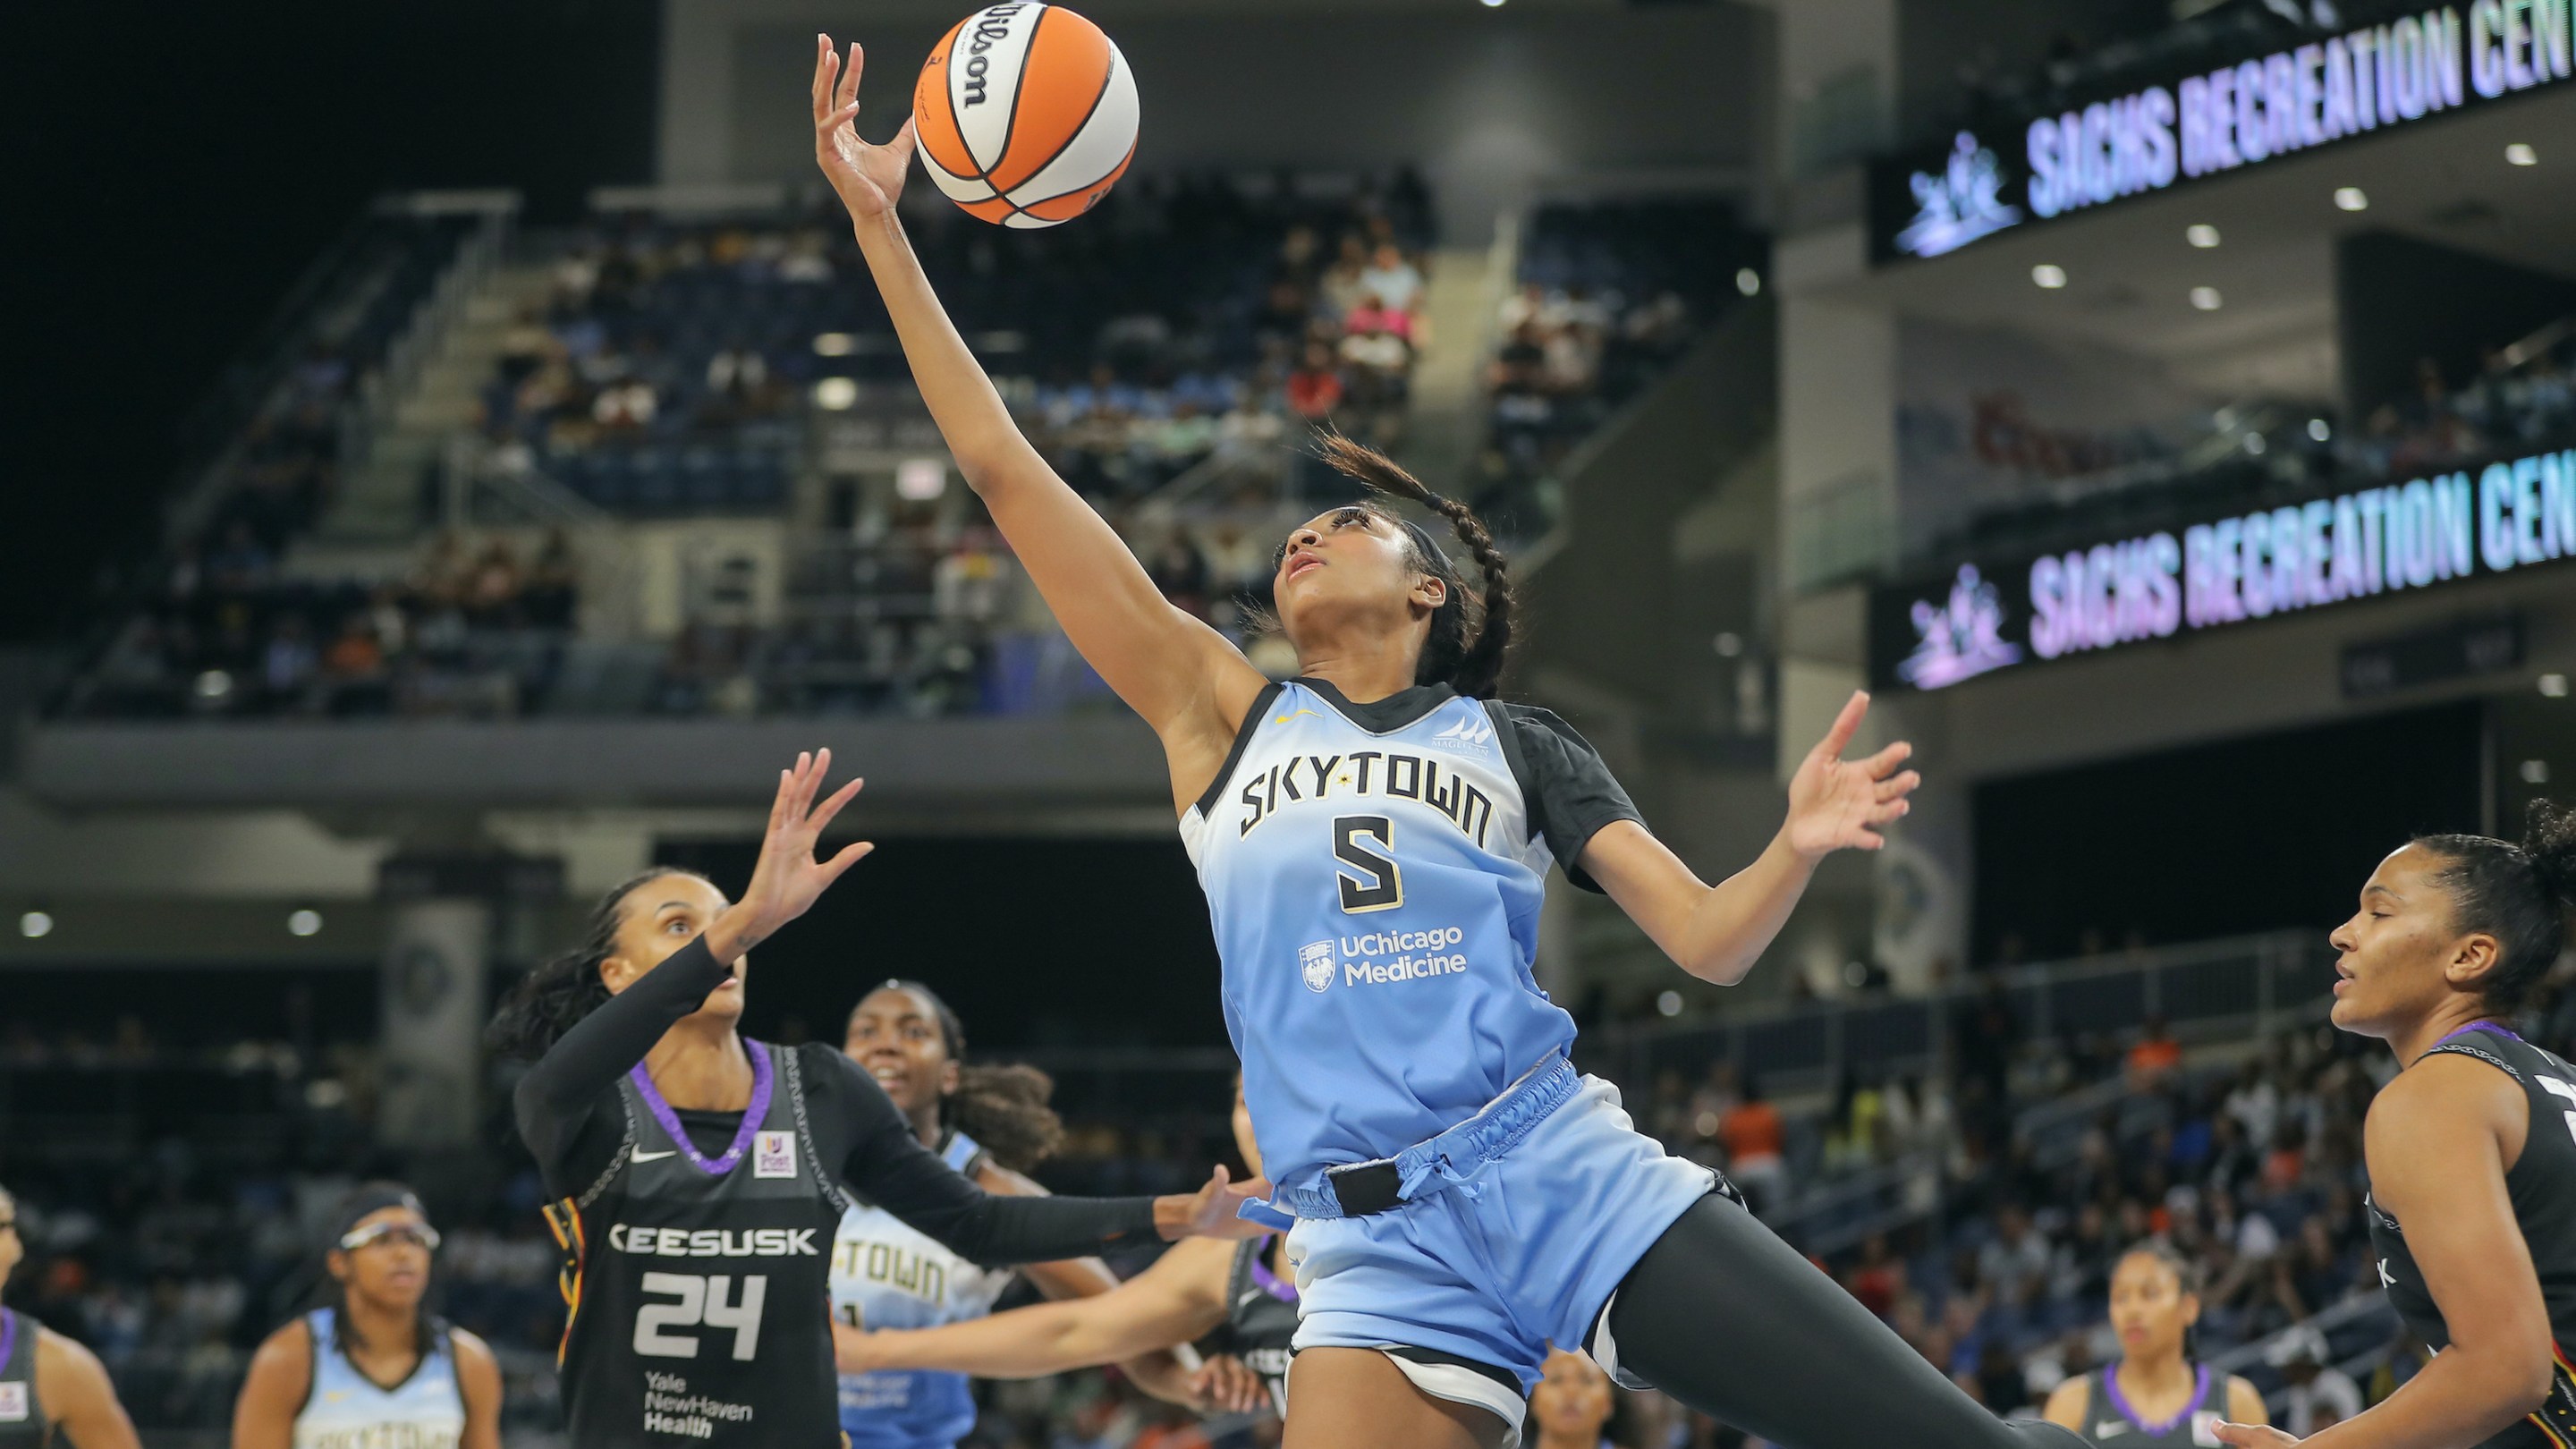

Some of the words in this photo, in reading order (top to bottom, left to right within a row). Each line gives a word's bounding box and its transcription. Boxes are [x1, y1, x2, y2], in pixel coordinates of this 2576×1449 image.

[2028, 86, 2177, 218] SACHS
[2180, 4, 2463, 178] RECREATION
[2470, 0, 2576, 99] CEN
[2029, 531, 2181, 659] SACHS
[2184, 470, 2473, 629] RECREATION
[1333, 815, 1404, 914] 5
[1341, 926, 1463, 958] UChicago
[1343, 953, 1467, 987] Medicine
[633, 1271, 767, 1361] 24
[644, 1370, 688, 1394] Yale
[644, 1411, 714, 1439] Health
